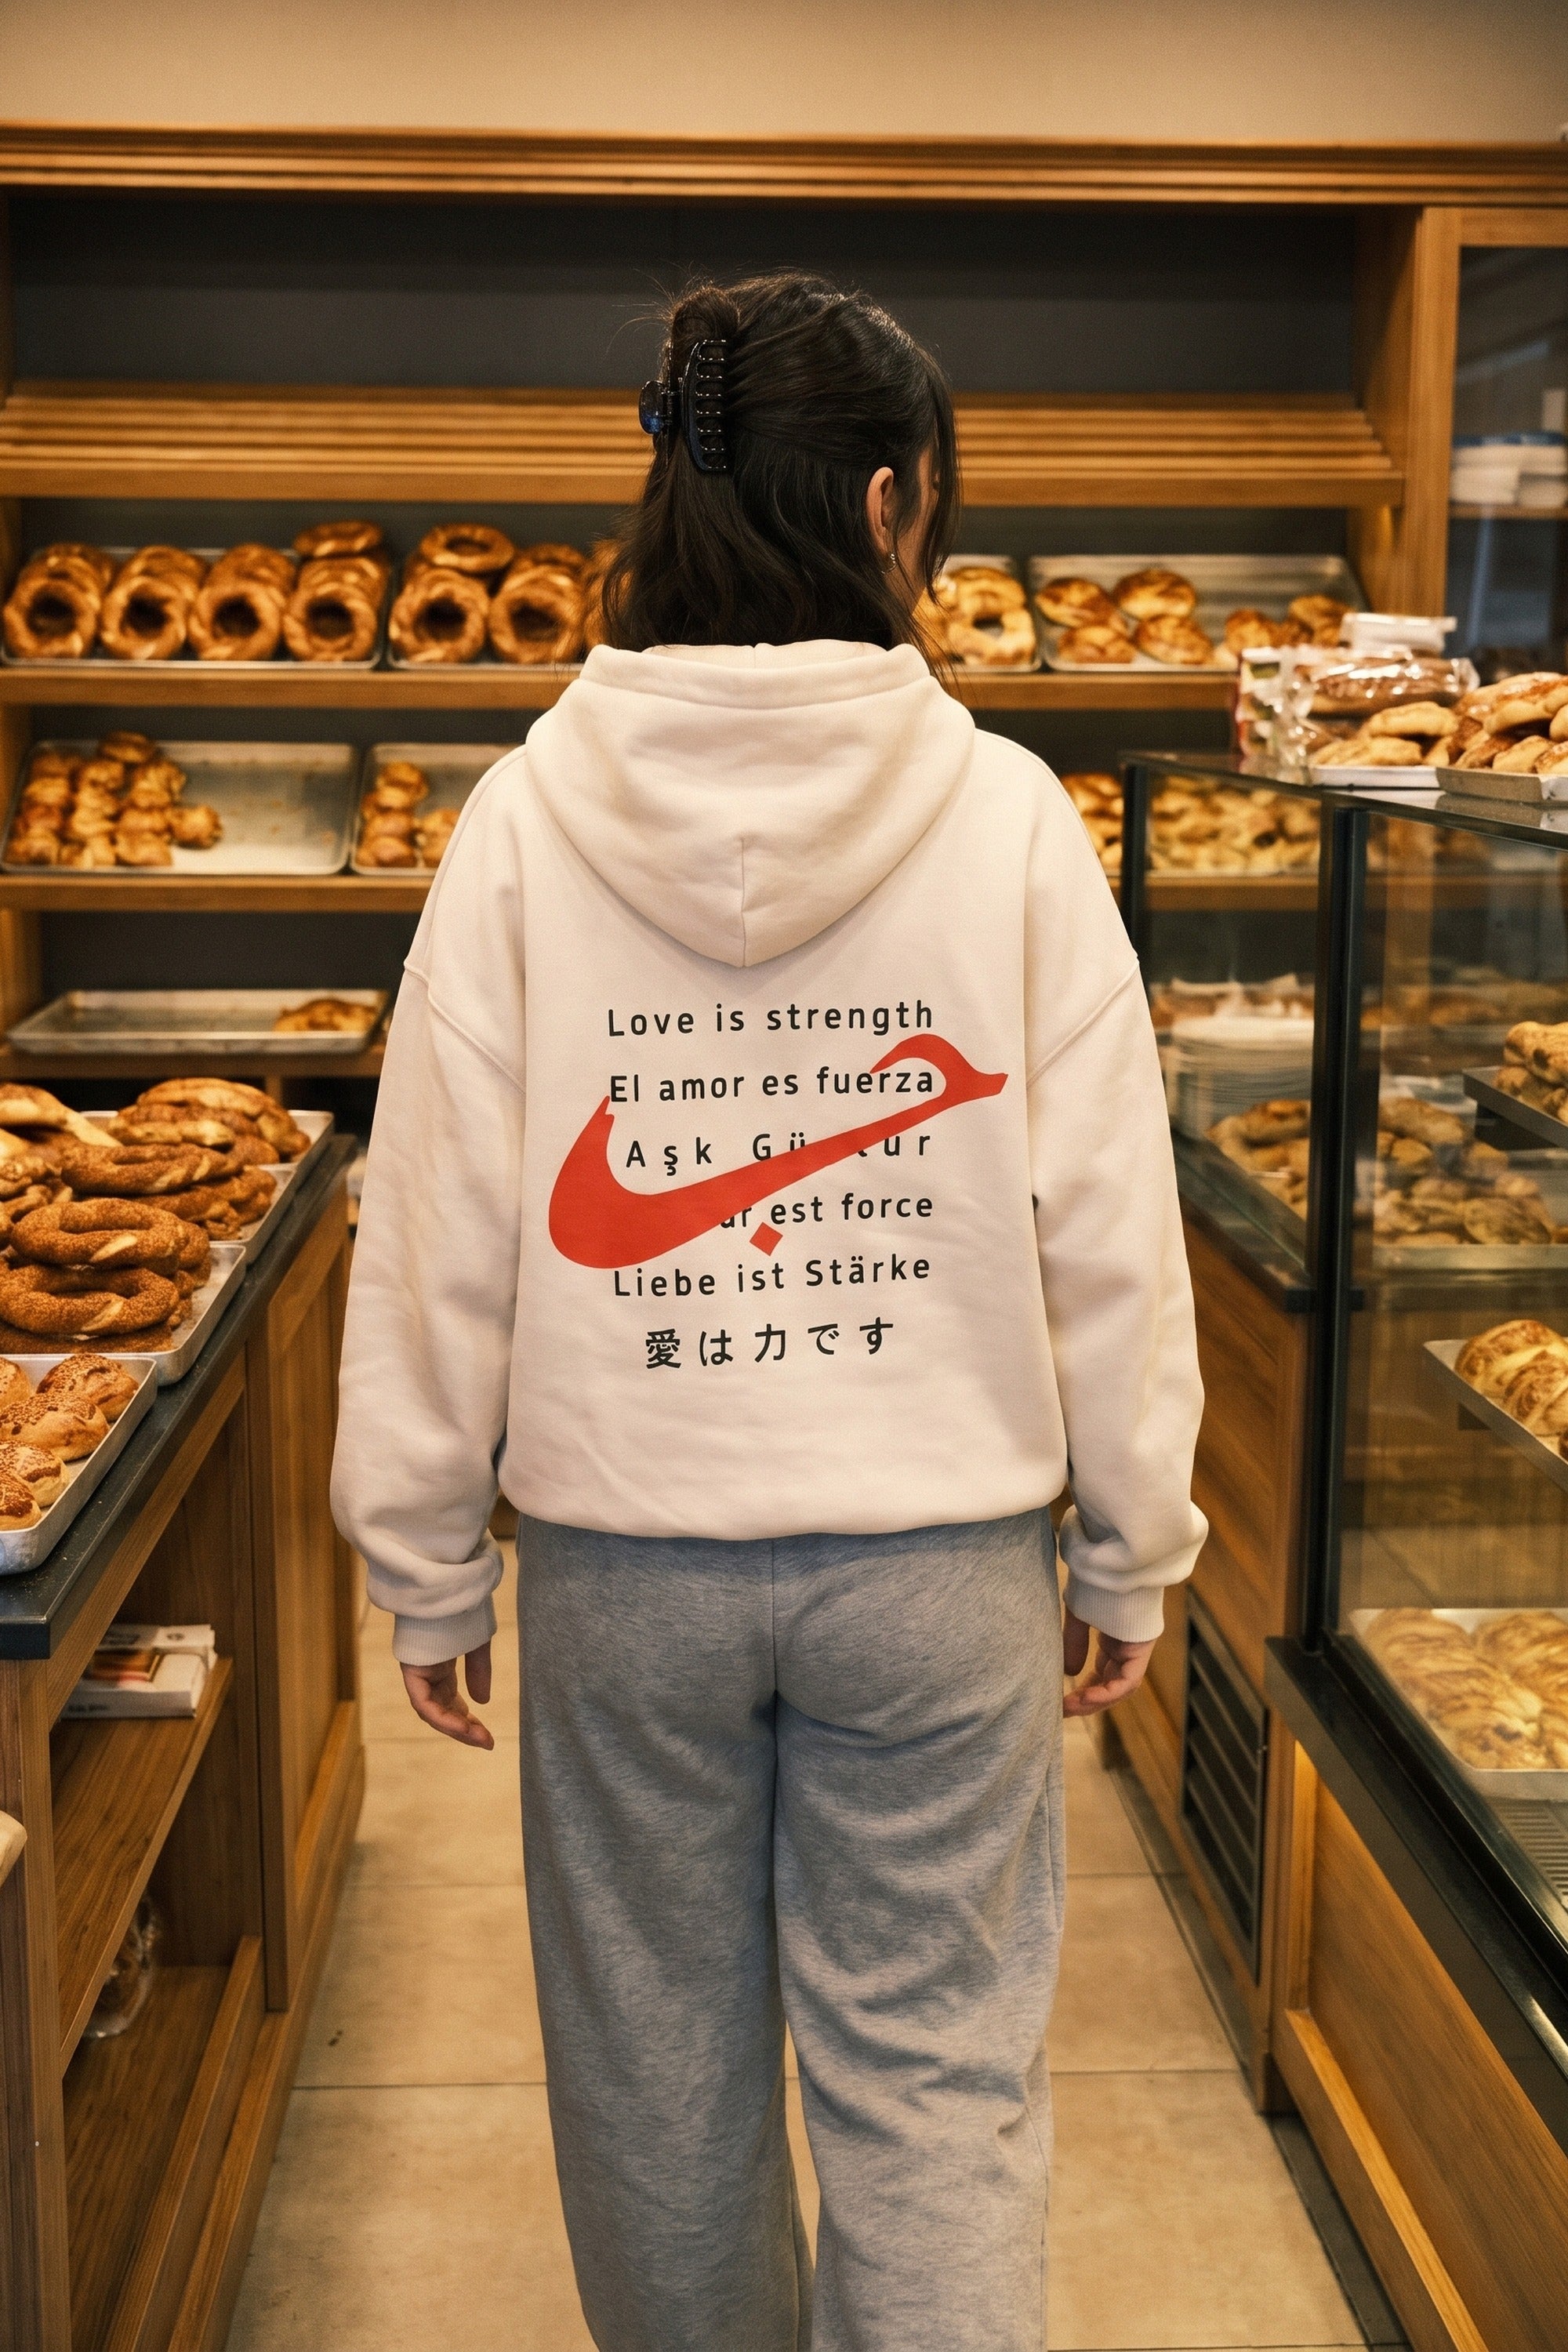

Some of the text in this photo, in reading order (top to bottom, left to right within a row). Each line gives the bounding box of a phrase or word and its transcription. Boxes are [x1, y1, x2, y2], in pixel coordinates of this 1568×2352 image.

[608, 1000, 932, 1037] Love is strength
[610, 1065, 932, 1102] El amor es fuerza
[626, 1136, 712, 1177] Aşk
[771, 1196, 823, 1225] est
[840, 1192, 933, 1221] force
[614, 1253, 930, 1297] Liebe ist Stärke
[645, 1316, 894, 1370] 愛は力です
